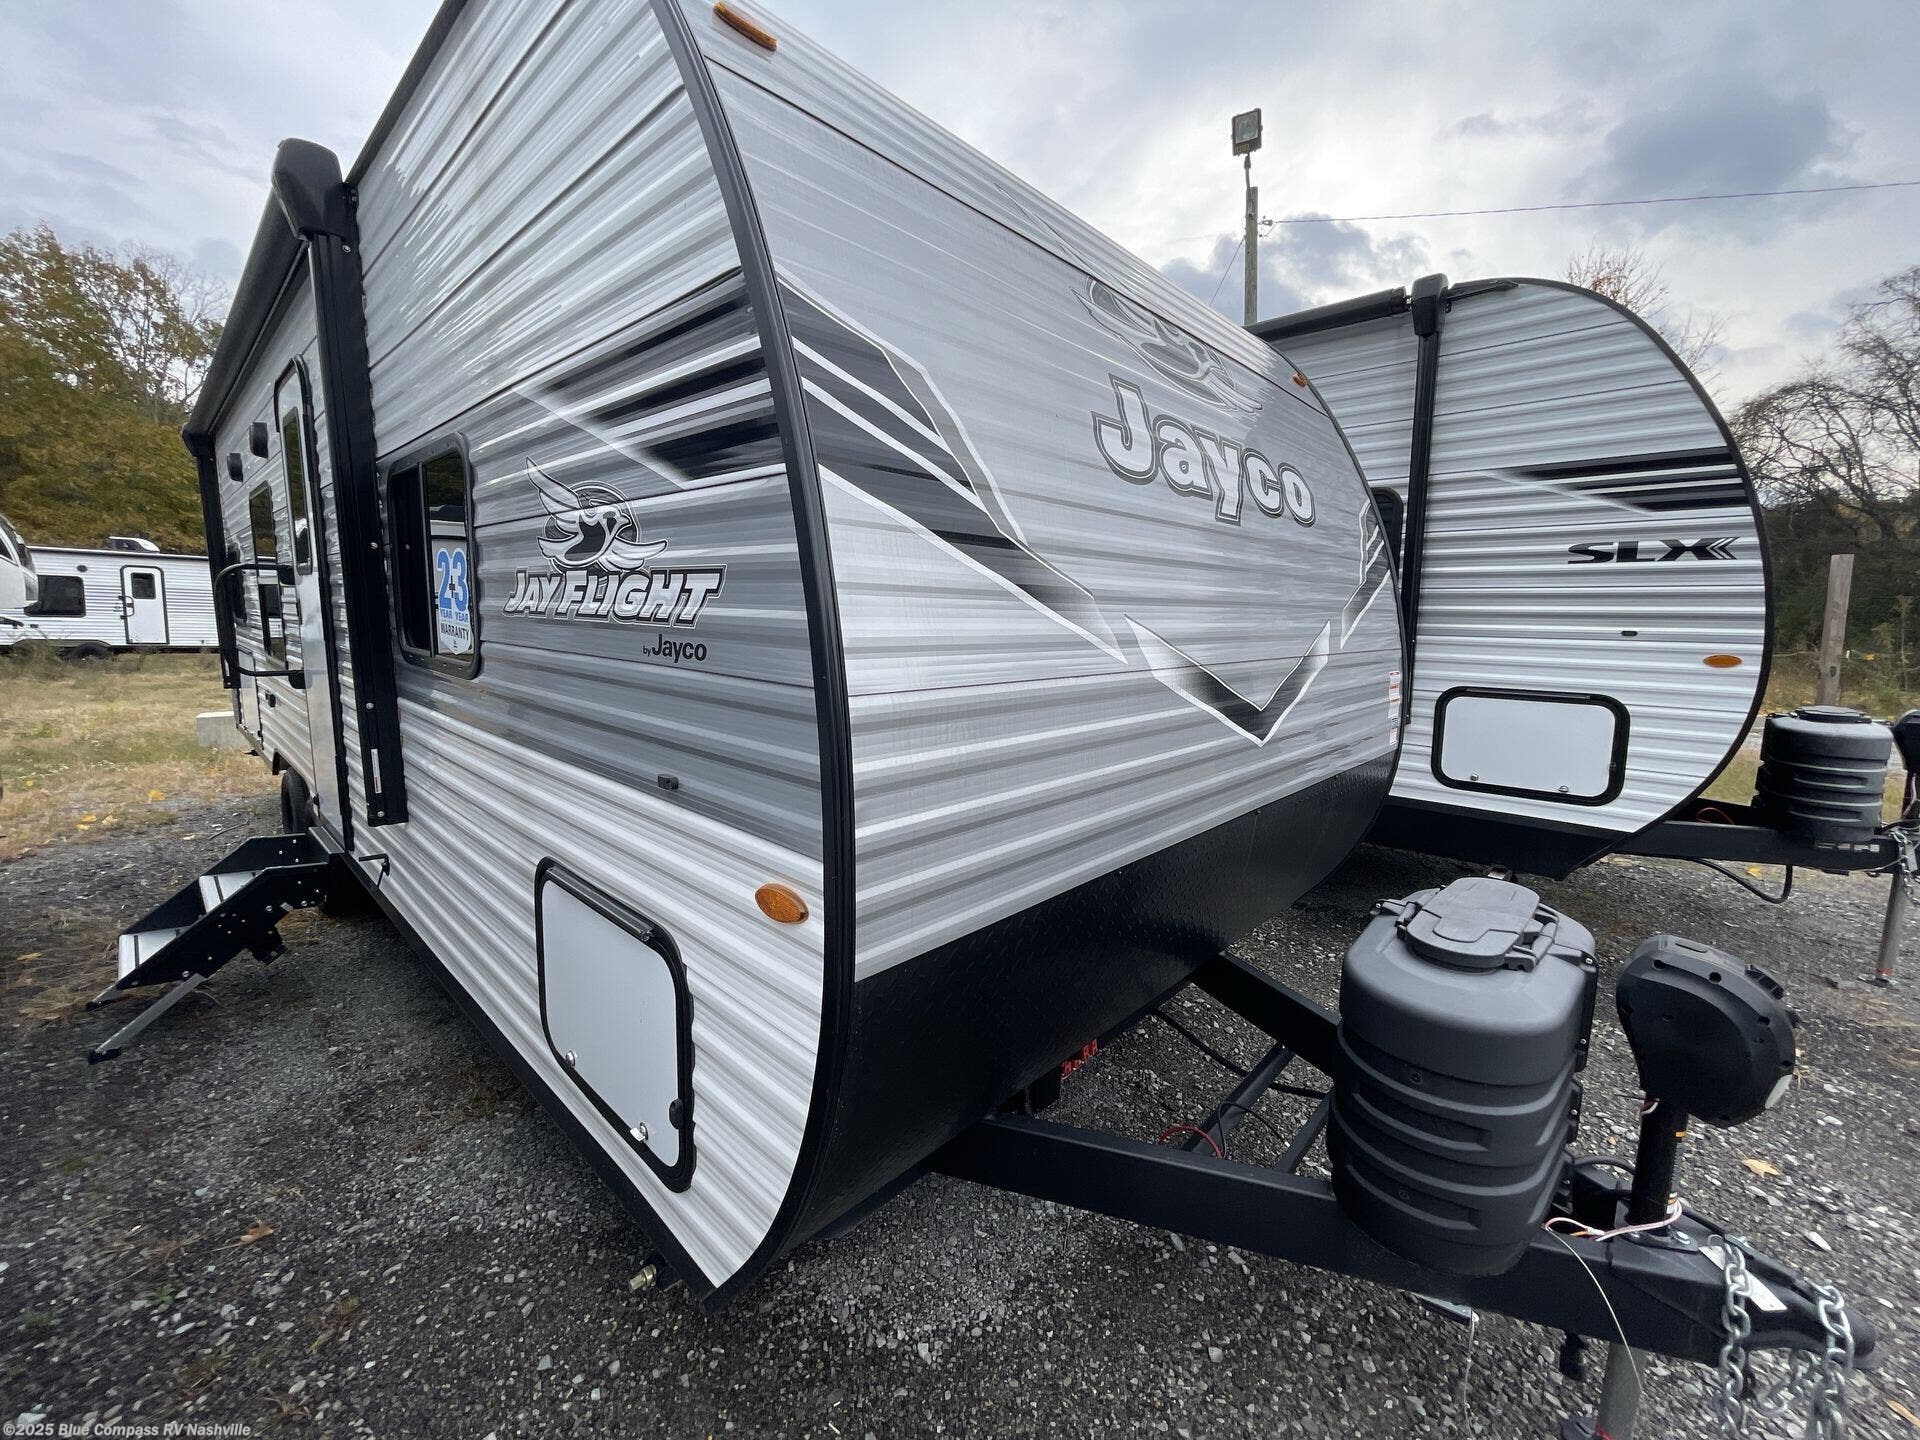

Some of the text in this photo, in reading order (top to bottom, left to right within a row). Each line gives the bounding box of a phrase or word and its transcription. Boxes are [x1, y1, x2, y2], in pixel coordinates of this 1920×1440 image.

[1091, 373, 1316, 527] Jayco
[1568, 537, 1739, 564] SLX
[440, 622, 470, 641] WARRANTY
[643, 633, 707, 664] by Jayco
